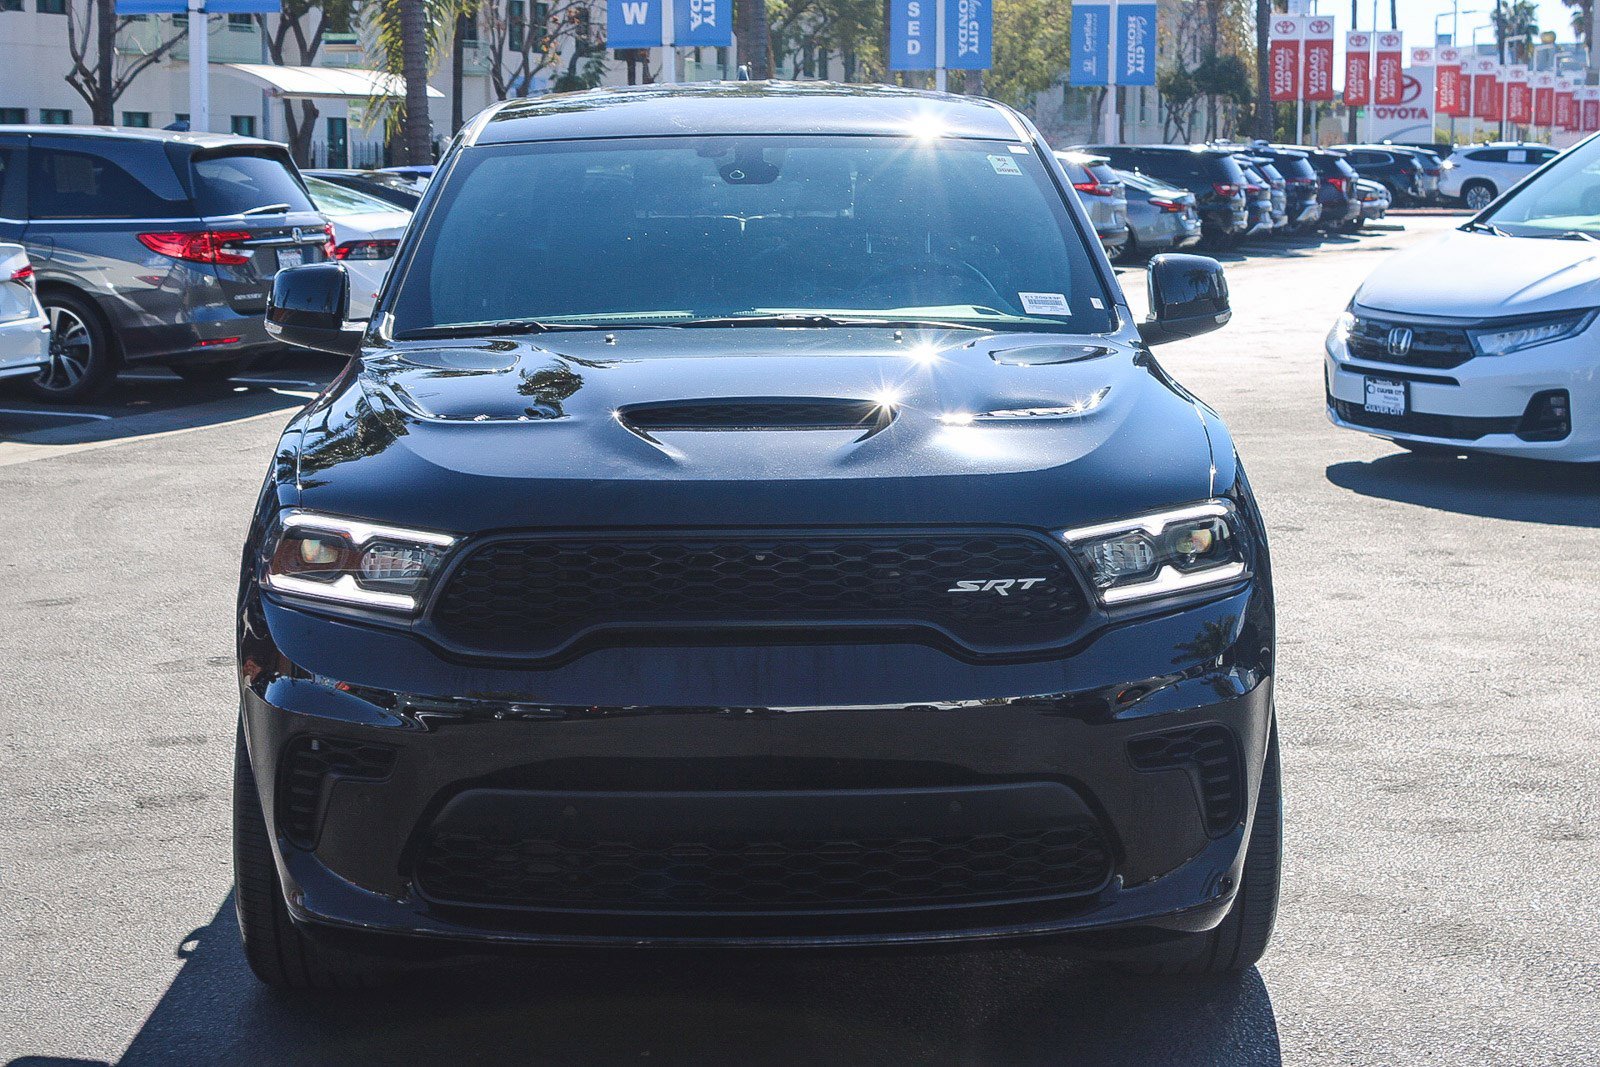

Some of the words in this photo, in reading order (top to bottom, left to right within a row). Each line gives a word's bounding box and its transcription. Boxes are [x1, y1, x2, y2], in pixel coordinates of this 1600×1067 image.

[958, 0, 968, 57] ONDA
[968, 21, 979, 55] CITY
[1127, 15, 1136, 76] HONDA
[1136, 45, 1145, 74] CITY
[1275, 47, 1284, 95] TOYOTA
[1309, 47, 1319, 95] TOYOTA
[1284, 71, 1292, 92] CITY
[1319, 71, 1327, 92] CITY
[1348, 58, 1357, 100] TOYOTA
[1379, 58, 1389, 100] TOYOTA
[1440, 71, 1448, 108] TOYOTA
[1367, 107, 1428, 119] OYOTA
[947, 577, 1047, 596] SRT
